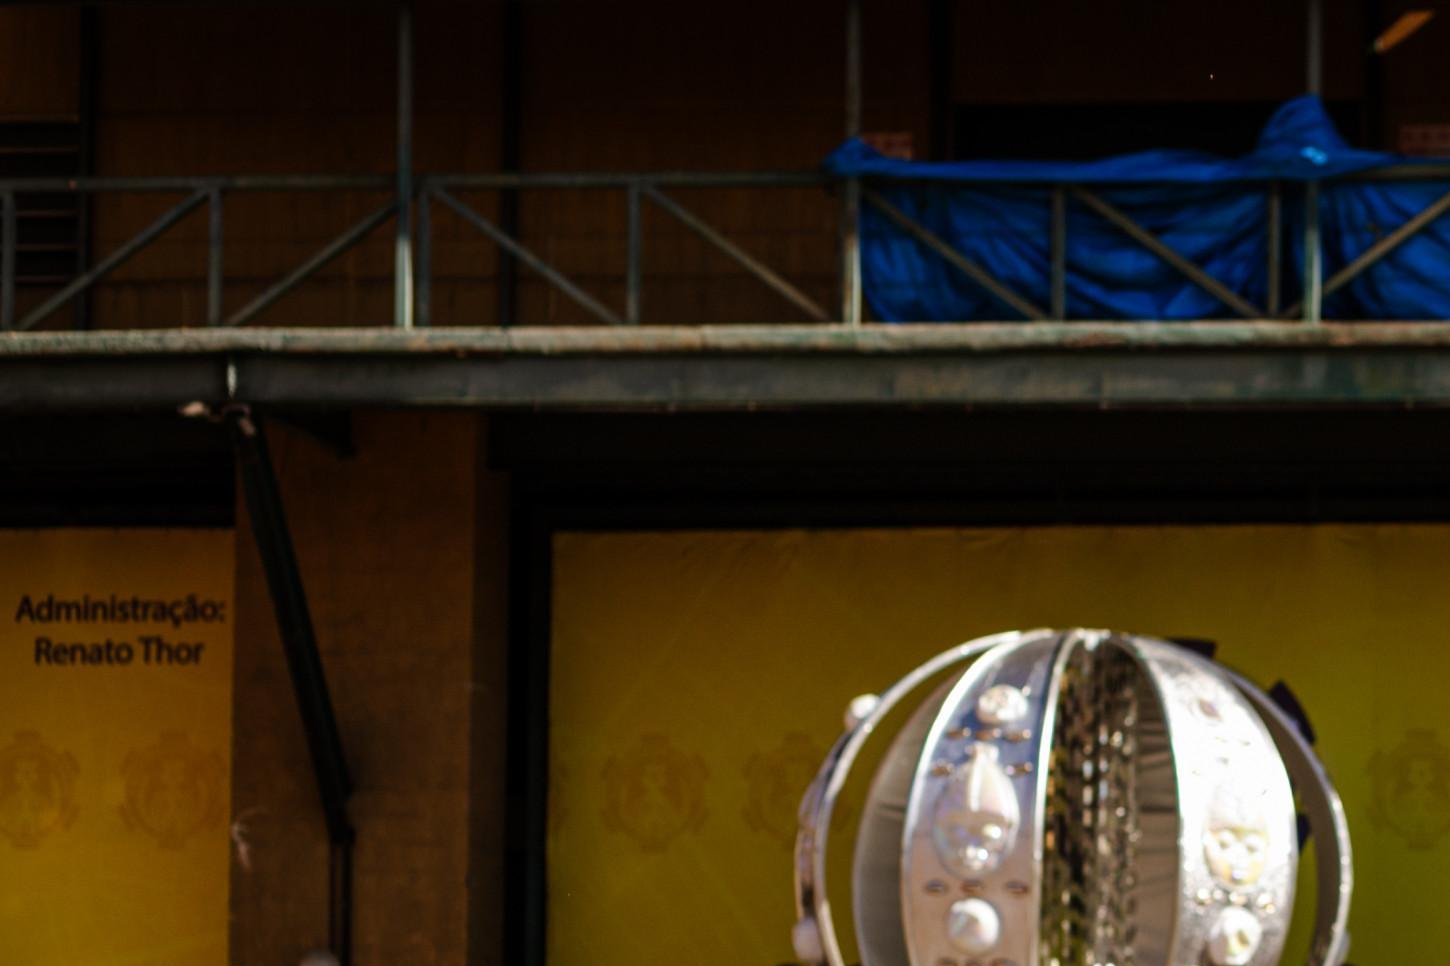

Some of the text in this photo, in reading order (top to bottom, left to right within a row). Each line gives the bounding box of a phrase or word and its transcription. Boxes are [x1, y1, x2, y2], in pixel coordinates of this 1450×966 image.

[15, 592, 225, 628] Administração:
[35, 634, 204, 664] Renato Thor
